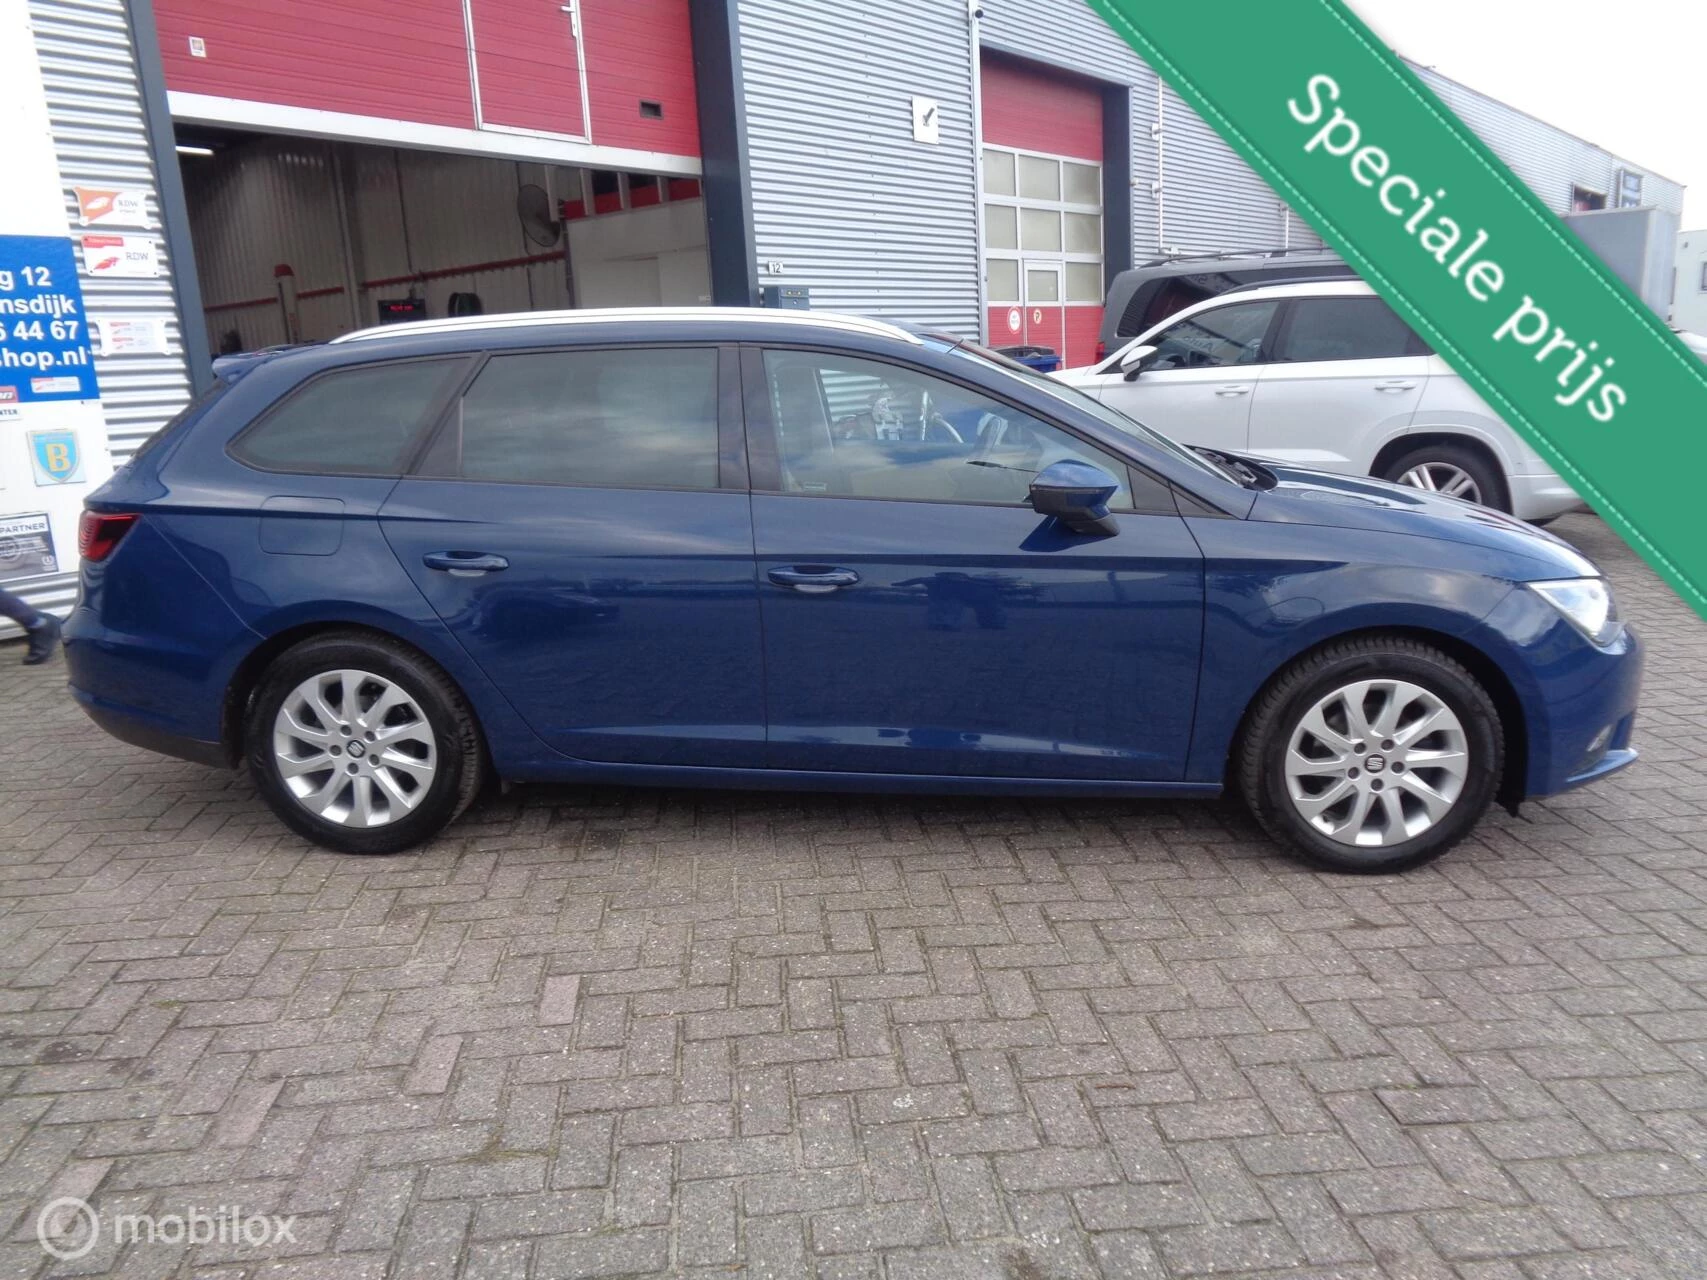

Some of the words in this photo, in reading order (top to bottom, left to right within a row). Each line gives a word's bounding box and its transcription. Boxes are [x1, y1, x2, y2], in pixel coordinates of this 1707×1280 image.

[125, 252, 149, 260] RDW
[21, 266, 52, 286] 12
[772, 263, 781, 273] 12
[0, 294, 77, 319] nsdijk
[13, 320, 44, 341] 44
[50, 320, 79, 341] 67
[0, 346, 88, 371] hop.nl
[47, 443, 70, 472] B
